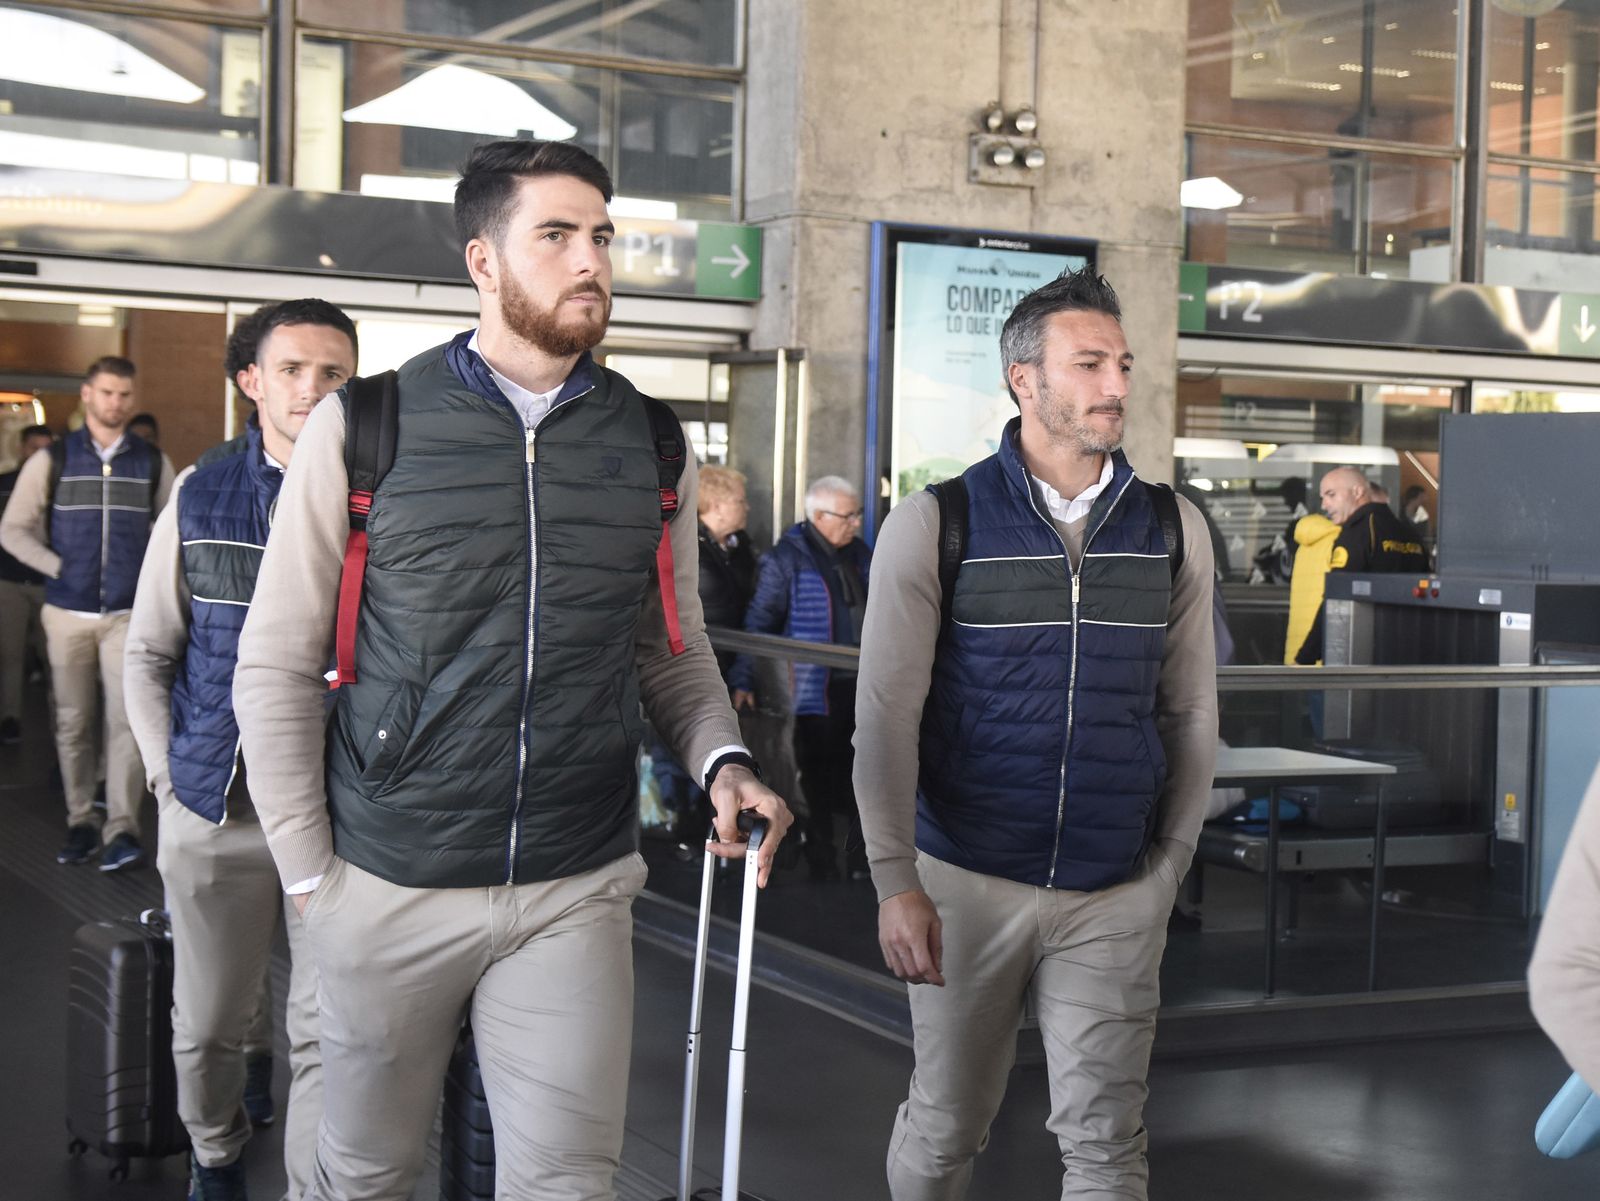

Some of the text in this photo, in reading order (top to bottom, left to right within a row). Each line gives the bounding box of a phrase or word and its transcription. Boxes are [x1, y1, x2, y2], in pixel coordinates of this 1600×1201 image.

[624, 231, 680, 277] P1
[1219, 280, 1263, 323] P2
[946, 315, 962, 333] LO
[966, 316, 991, 336] QUE
